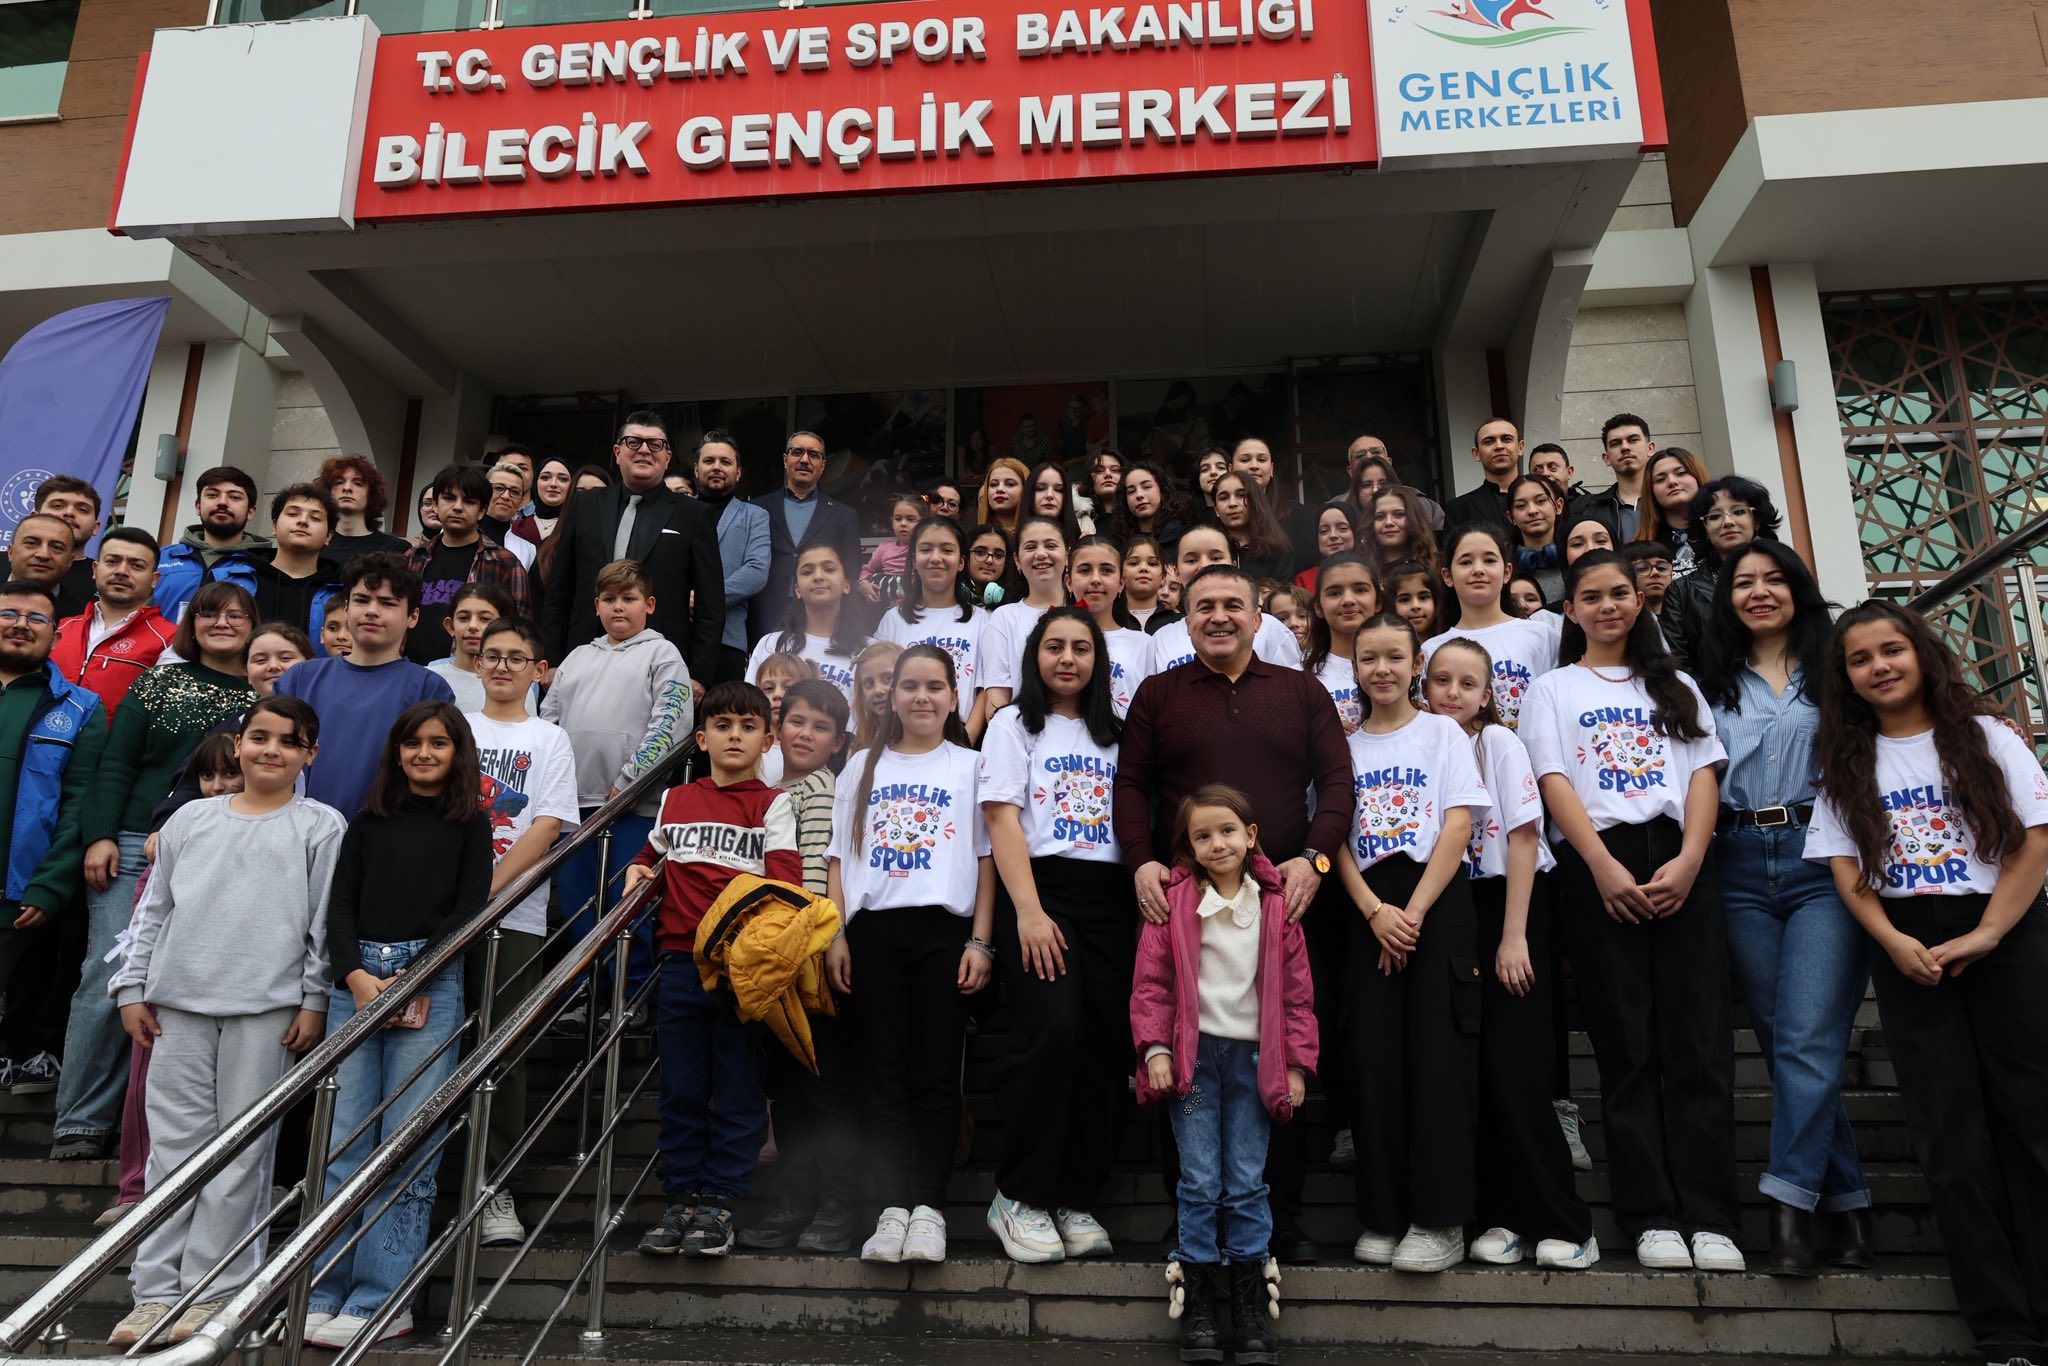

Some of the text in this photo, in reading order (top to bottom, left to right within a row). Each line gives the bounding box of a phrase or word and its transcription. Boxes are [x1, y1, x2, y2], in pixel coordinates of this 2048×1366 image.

[416, 48, 506, 92] T.C.
[521, 27, 749, 87] GENÇLİK
[762, 27, 830, 72] VE
[845, 17, 986, 67] SPOR
[1399, 62, 1614, 102] GENÇLİK
[374, 72, 1351, 188] BİLECİK GENÇLİK MERKEZİ
[1400, 96, 1621, 132] MERKEZLERİ
[662, 825, 765, 860] MICHIGAN
